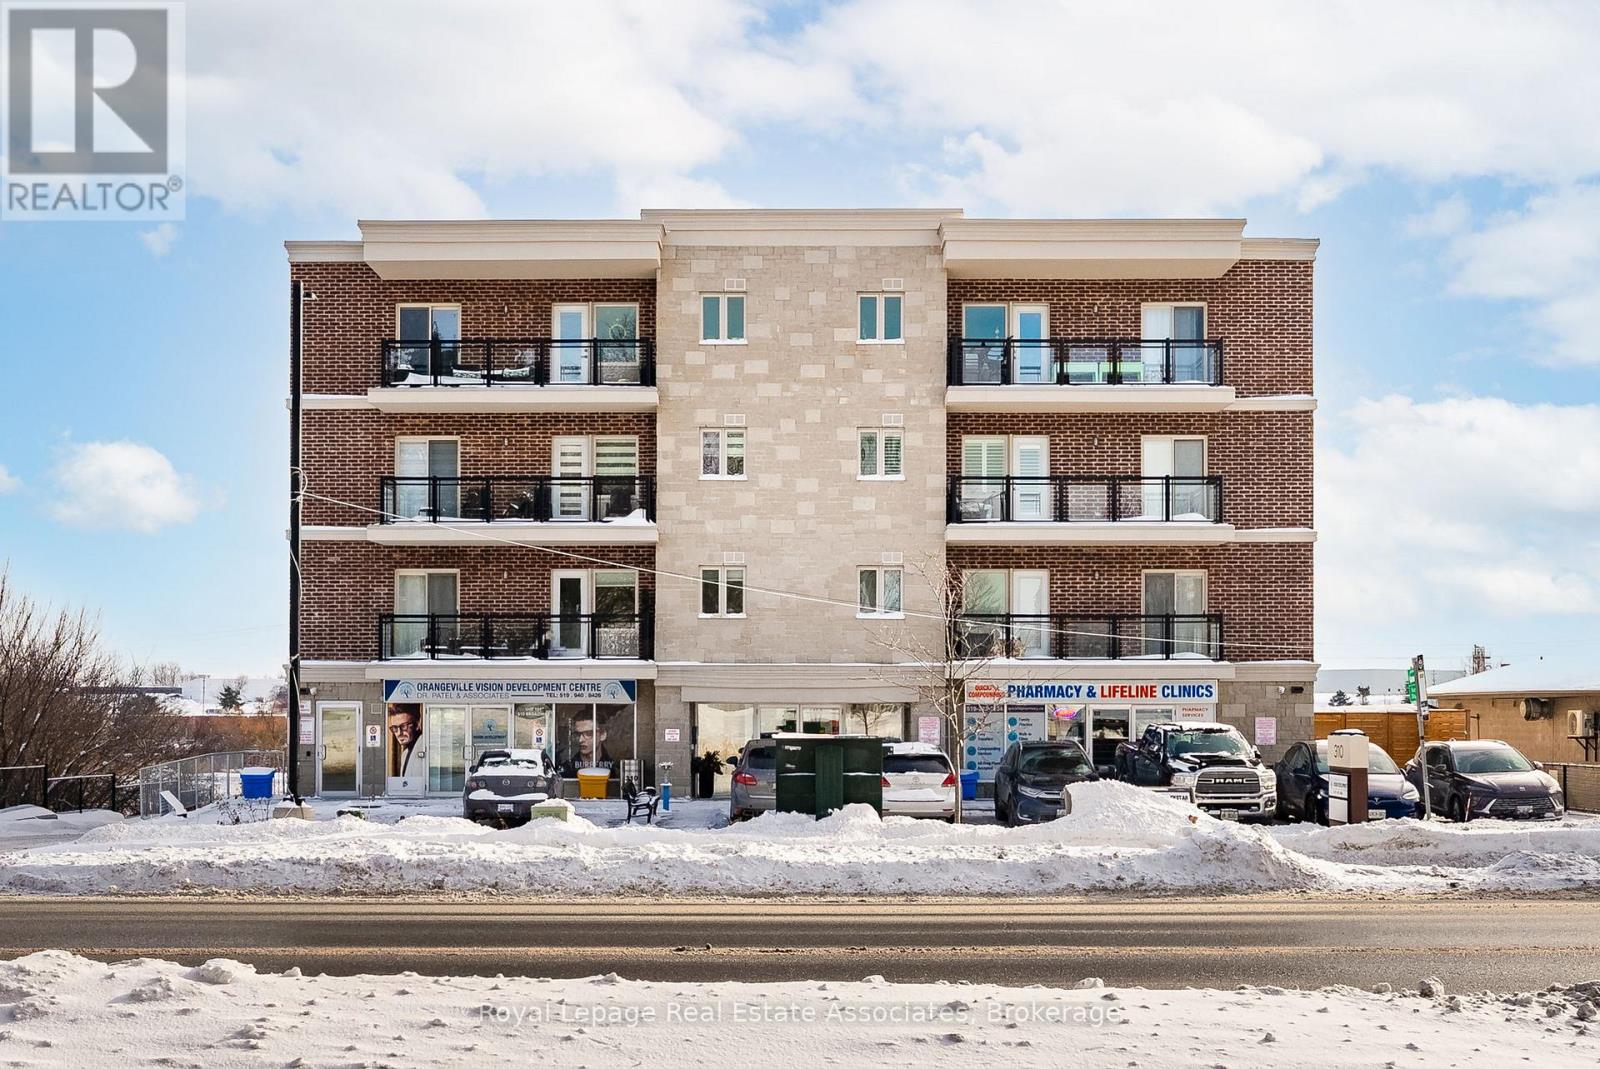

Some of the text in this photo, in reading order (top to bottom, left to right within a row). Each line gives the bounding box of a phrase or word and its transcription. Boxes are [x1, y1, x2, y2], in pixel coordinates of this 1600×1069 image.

[416, 682, 601, 692] ORANGEVILLE VISION DEVELOPMENT CENTRE
[1007, 685, 1214, 698] PHARMACY & LIFELINE CLINICS
